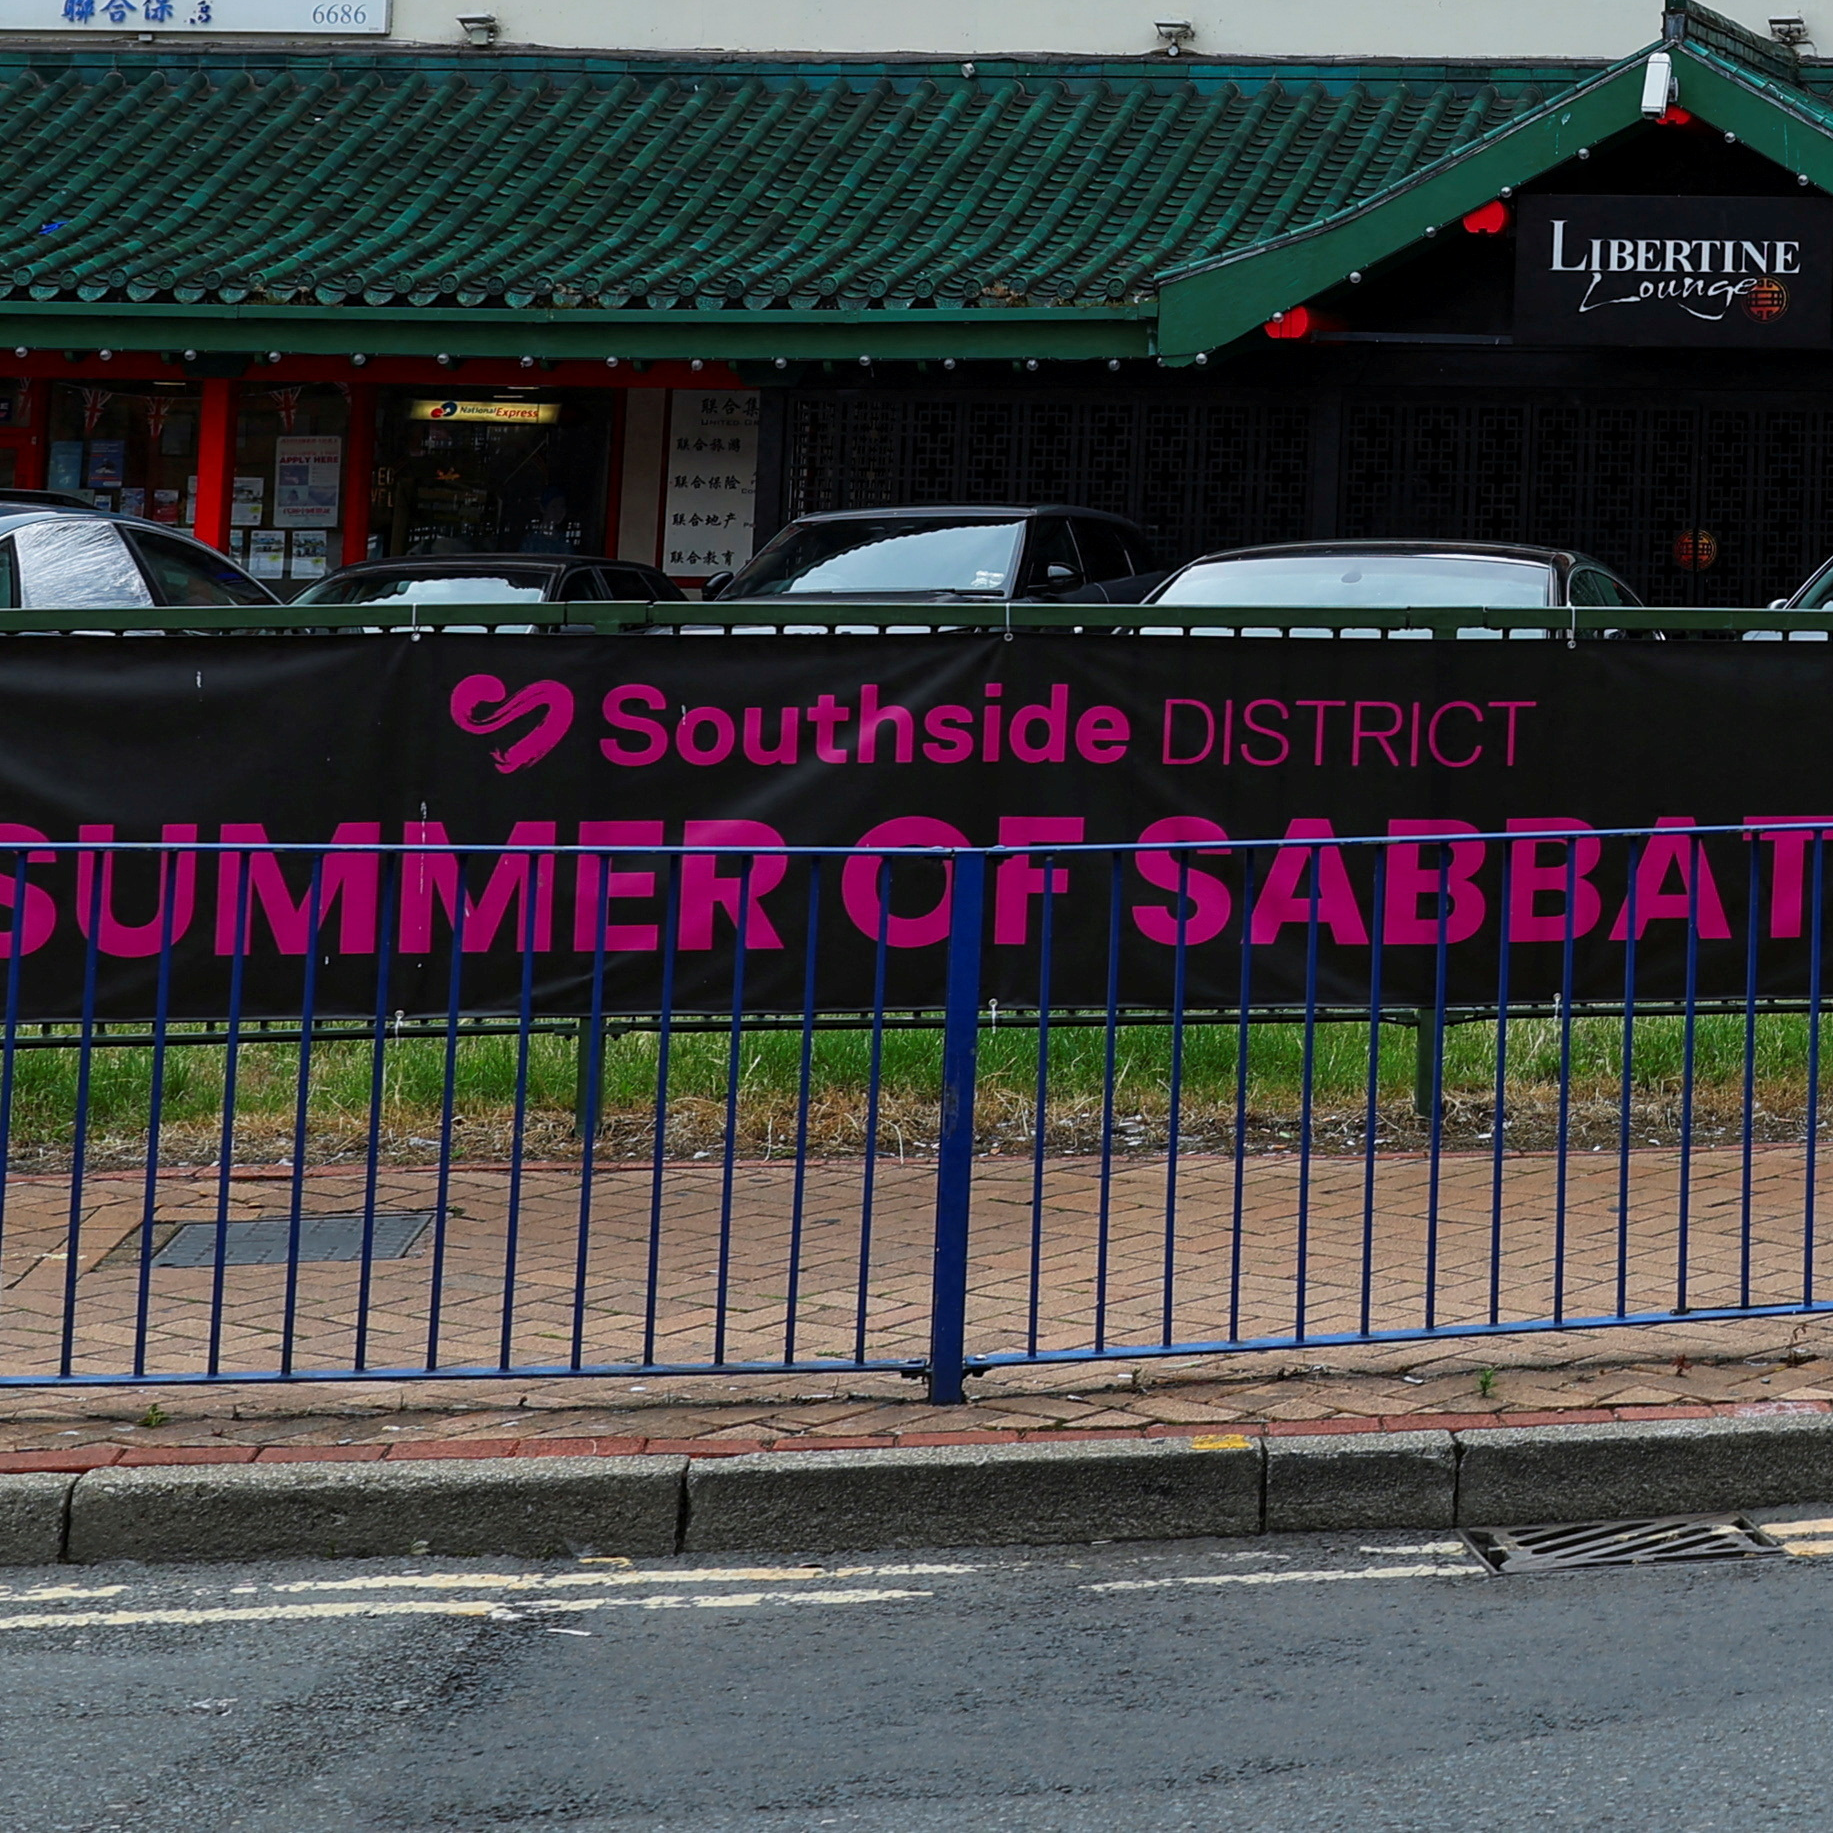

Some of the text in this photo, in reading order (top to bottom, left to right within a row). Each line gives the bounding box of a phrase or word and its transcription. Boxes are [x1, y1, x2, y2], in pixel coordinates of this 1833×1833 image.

[312, 4, 367, 26] 6686
[1549, 220, 1801, 274] LIBERTINE
[1578, 273, 1759, 320] Lounge
[600, 683, 1538, 768] Southside DISTRICT
[841, 815, 1085, 949] OF
